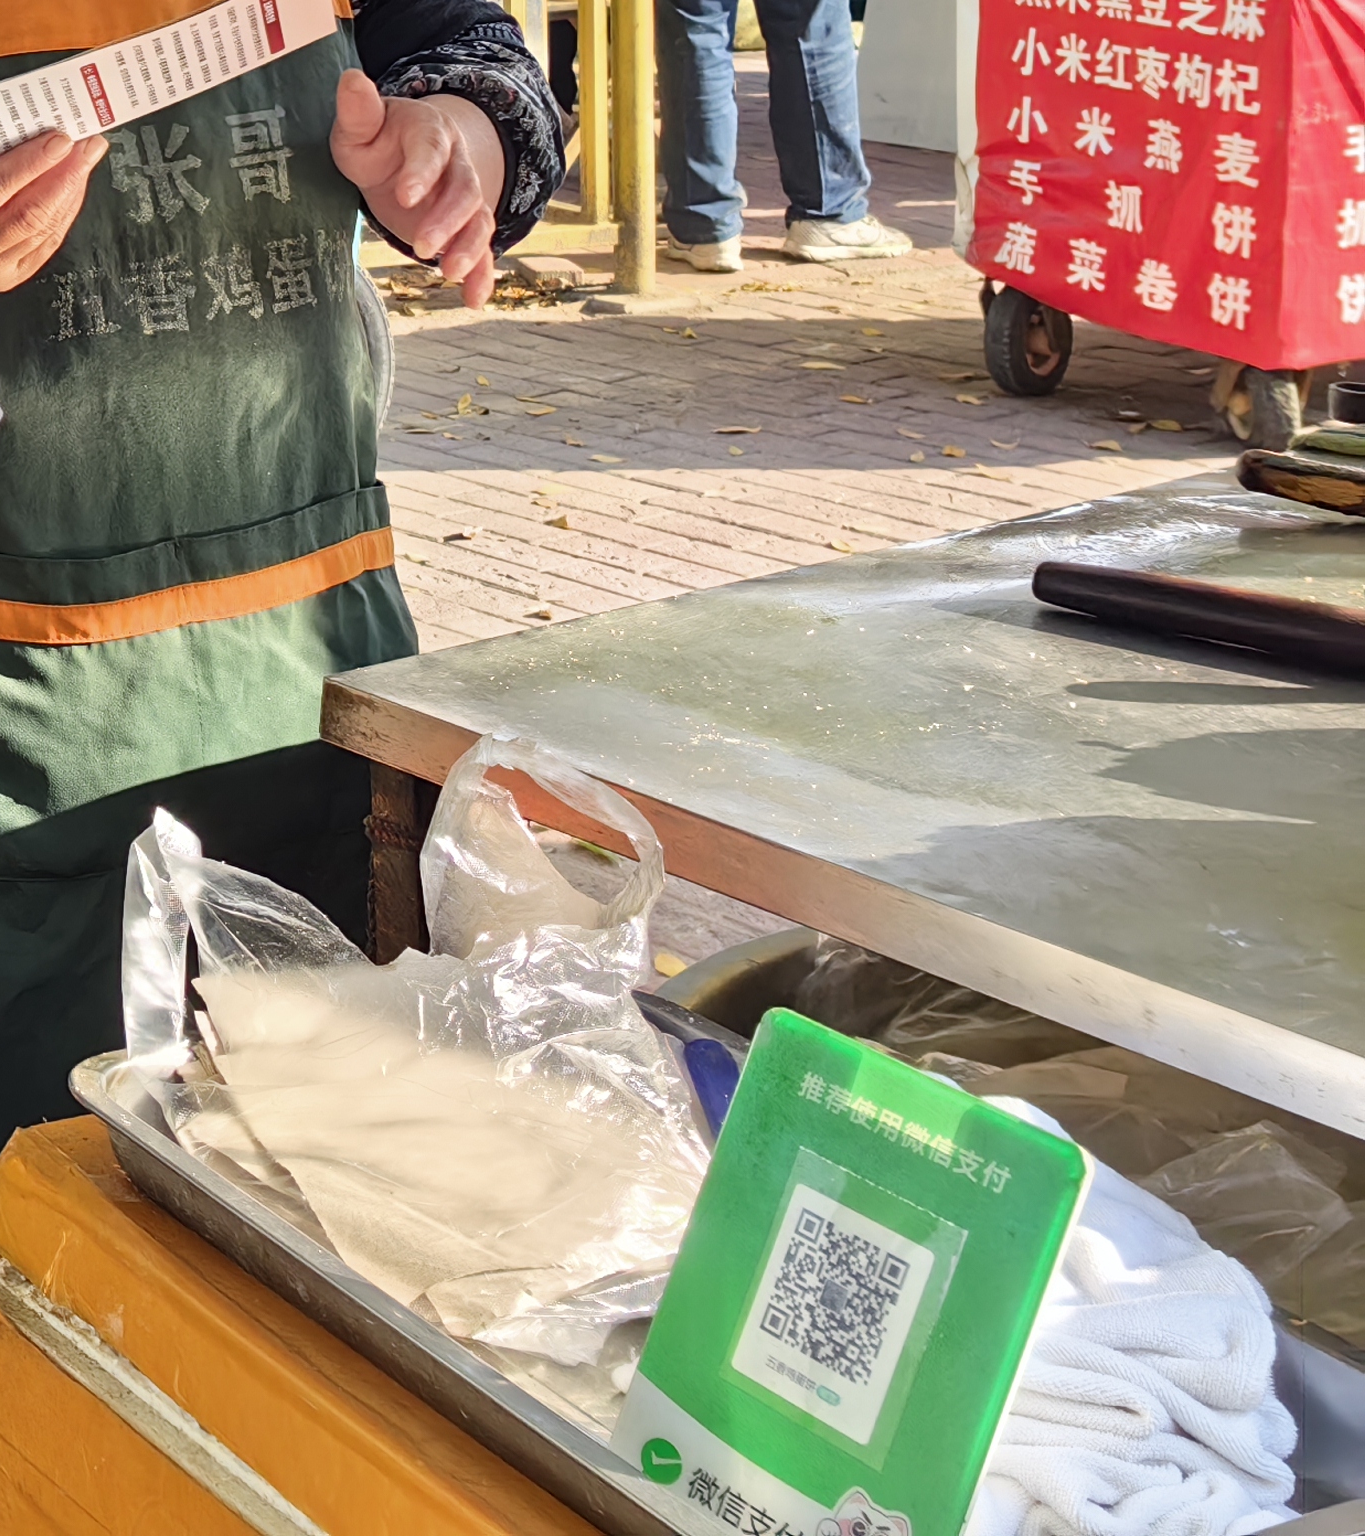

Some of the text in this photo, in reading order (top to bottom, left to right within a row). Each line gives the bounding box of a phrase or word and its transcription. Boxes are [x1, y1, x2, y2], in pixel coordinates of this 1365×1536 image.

[1011, 27, 1261, 115] 小米红枣枸杞
[106, 105, 293, 224] 张哥
[1007, 96, 1260, 189] 小米燕麦
[1007, 160, 1257, 260] 手抓饼
[995, 220, 1251, 332] 蔬菜卷饼
[798, 1070, 1013, 1195] 推荐使用微信支付
